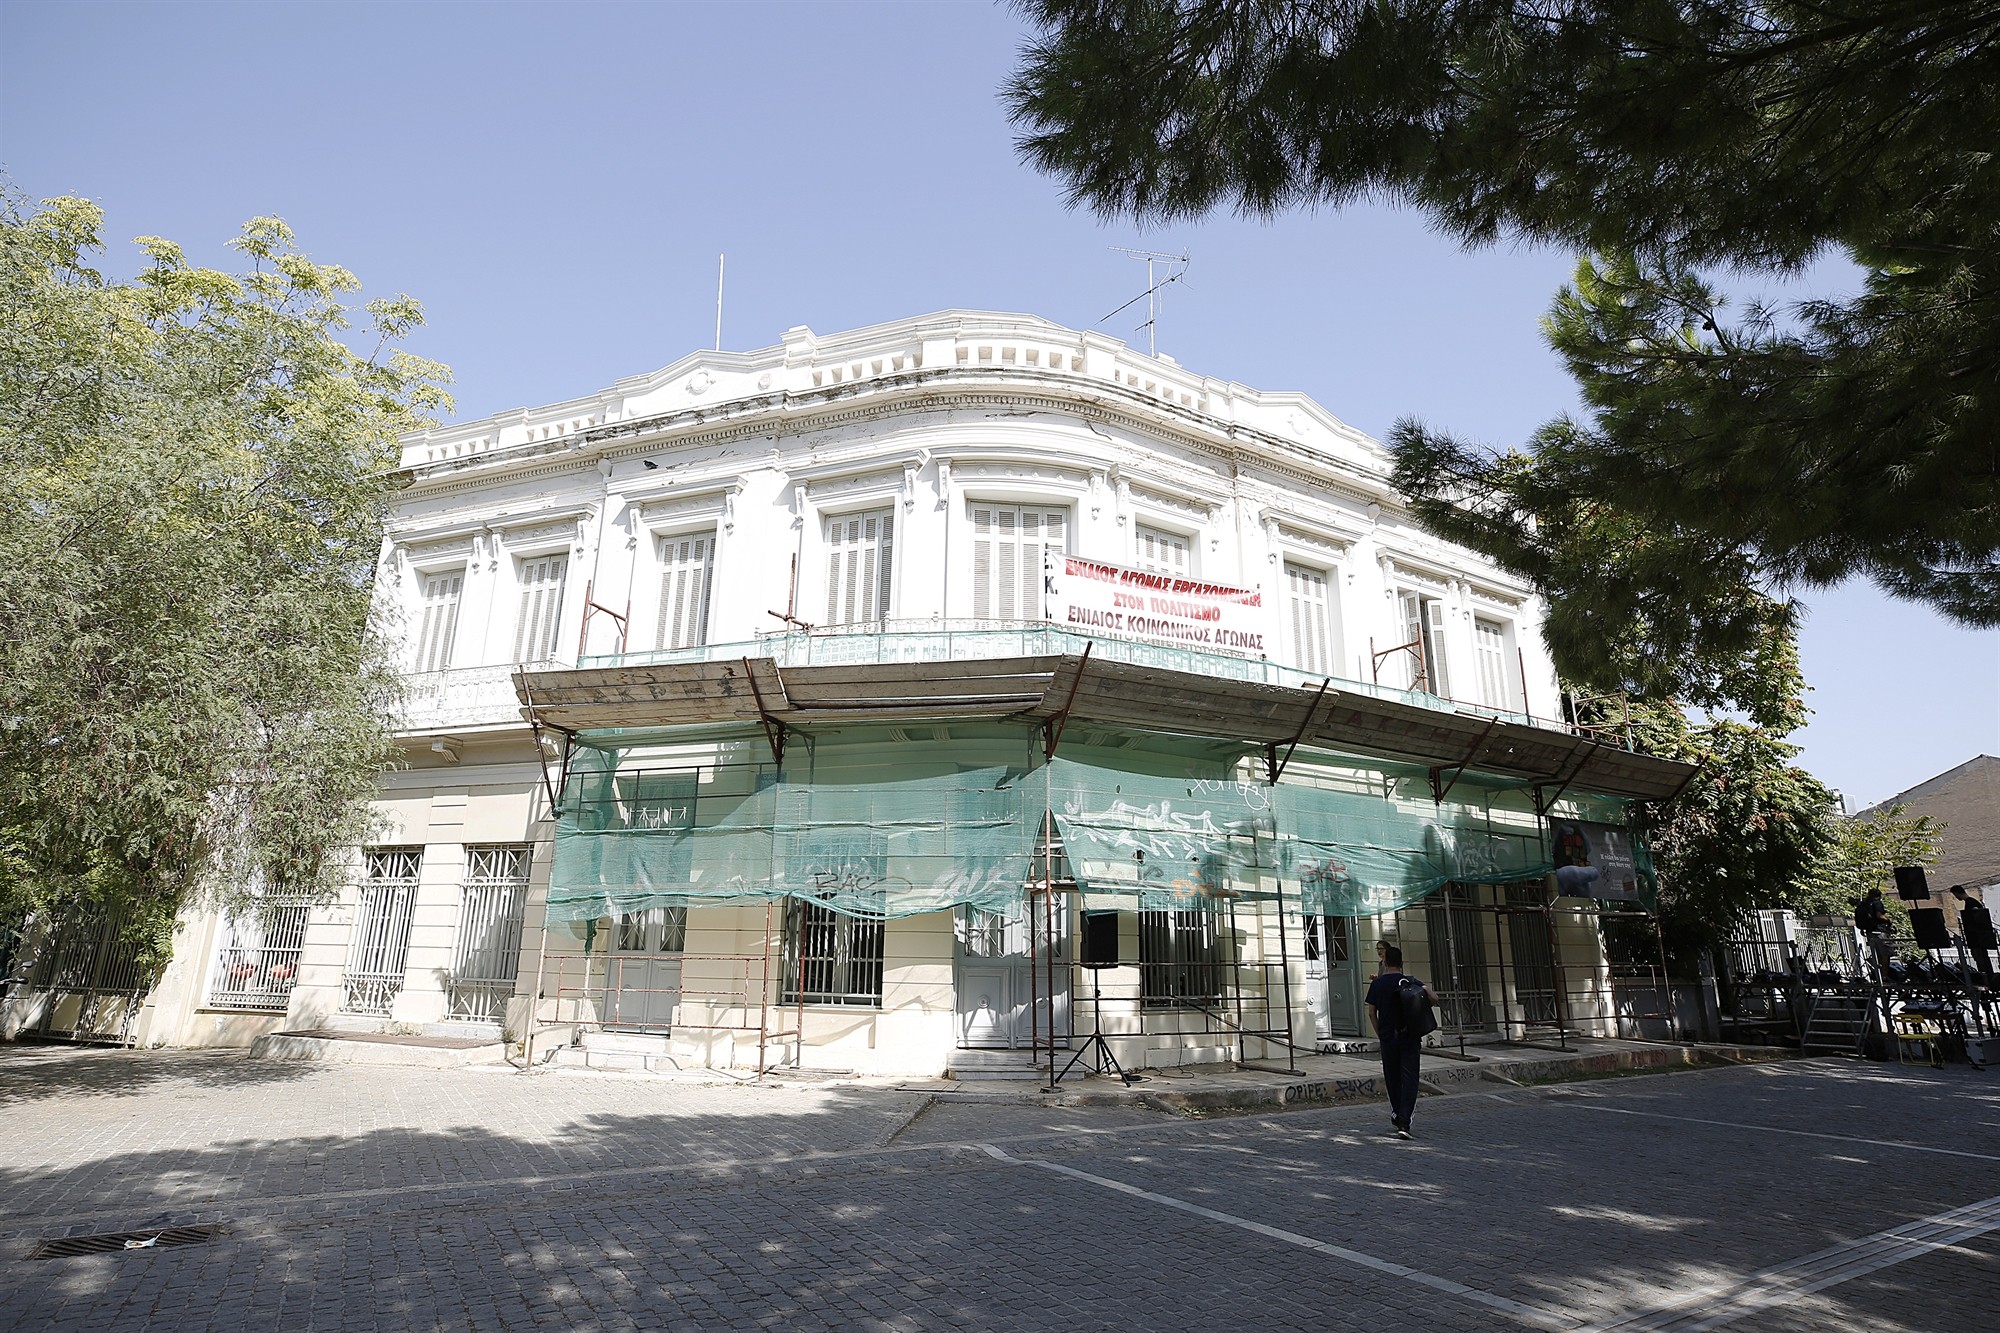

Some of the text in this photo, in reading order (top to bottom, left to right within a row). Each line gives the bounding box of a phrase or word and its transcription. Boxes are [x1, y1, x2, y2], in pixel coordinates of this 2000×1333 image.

[1065, 559, 1118, 584] ΕΝΙΑΙΟΣ
[1120, 570, 1171, 593] ΑΓΩΝΑΣ
[1113, 591, 1221, 622] ΣΤΟΝ ΠΟΛΙΤΙΣΜΟ
[1067, 605, 1123, 630] ΕΝΙΑΙΟΣ
[1127, 615, 1211, 643] ΚΟΙΝΩΝΙΚΟΣ
[1214, 628, 1264, 650] ΑΓΩΝΑΣ
